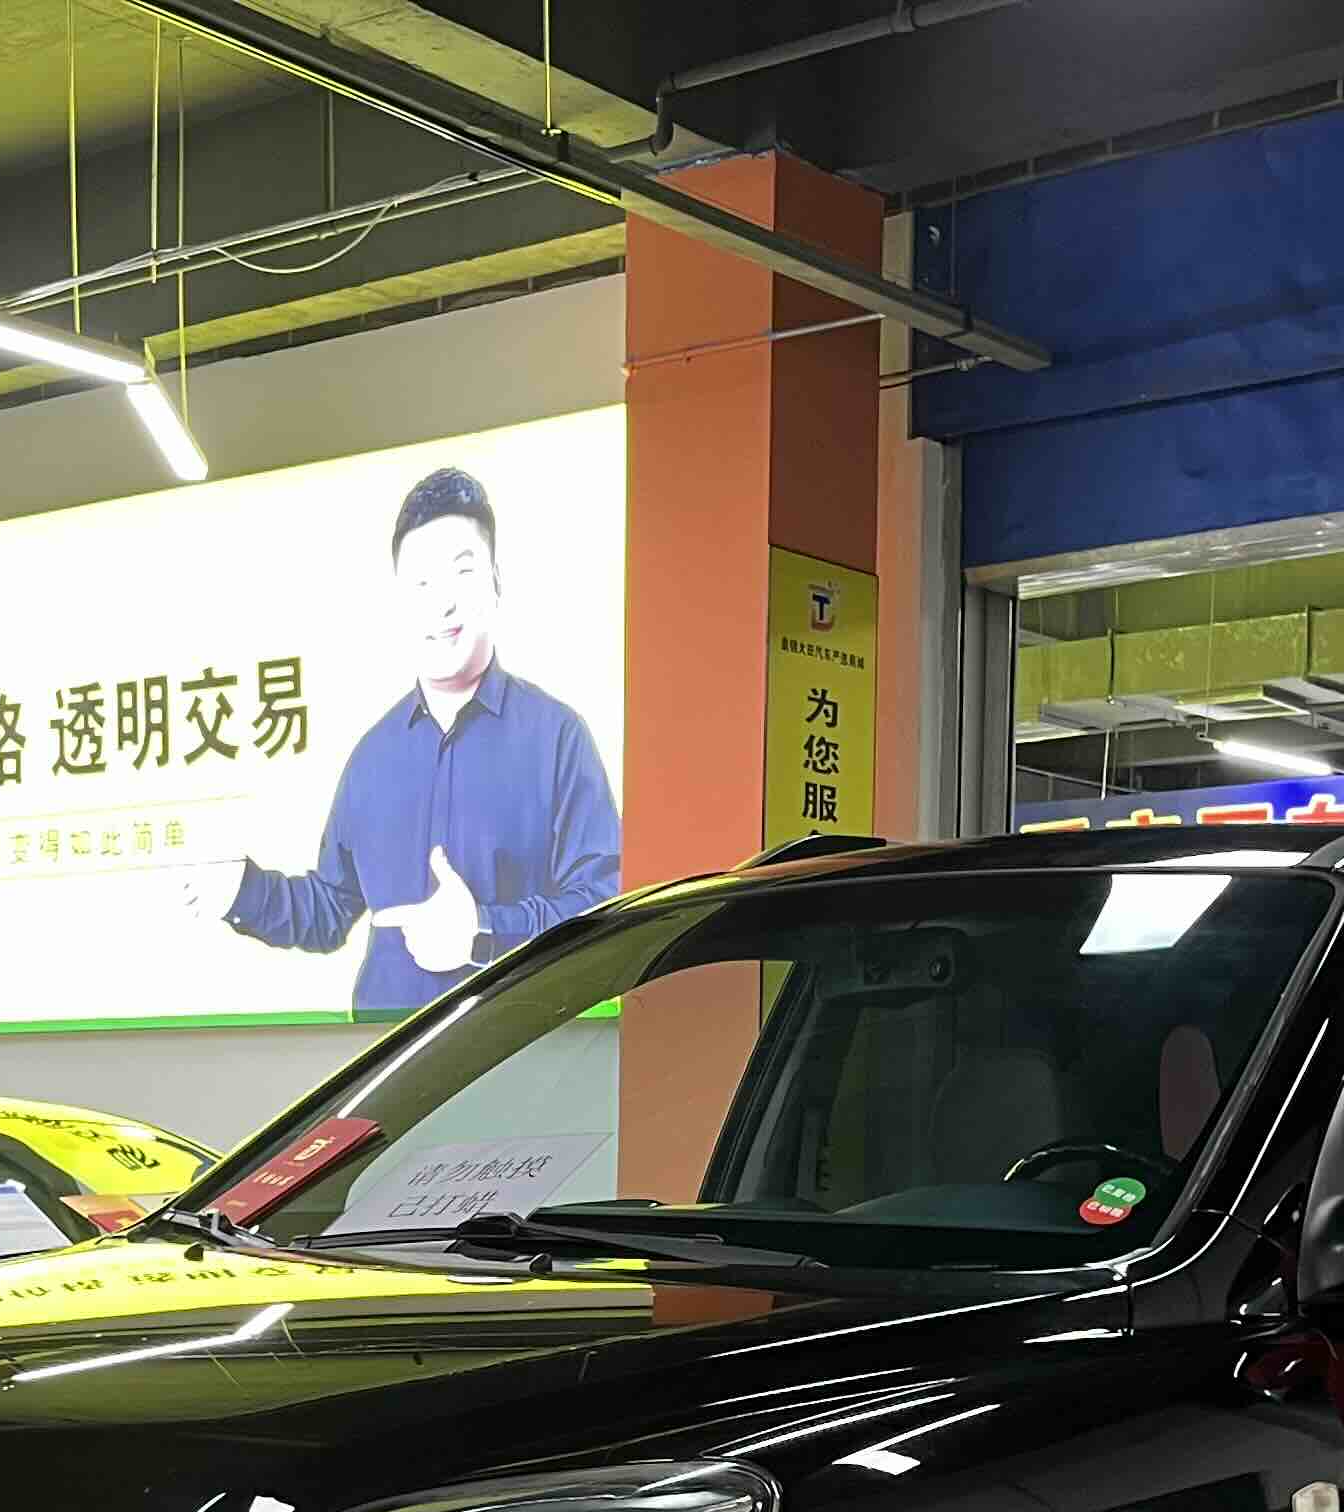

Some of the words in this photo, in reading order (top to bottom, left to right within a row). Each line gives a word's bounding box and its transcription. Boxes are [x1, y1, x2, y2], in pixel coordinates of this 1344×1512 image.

[50, 656, 308, 776] 透明交易
[801, 687, 840, 837] 为您服
